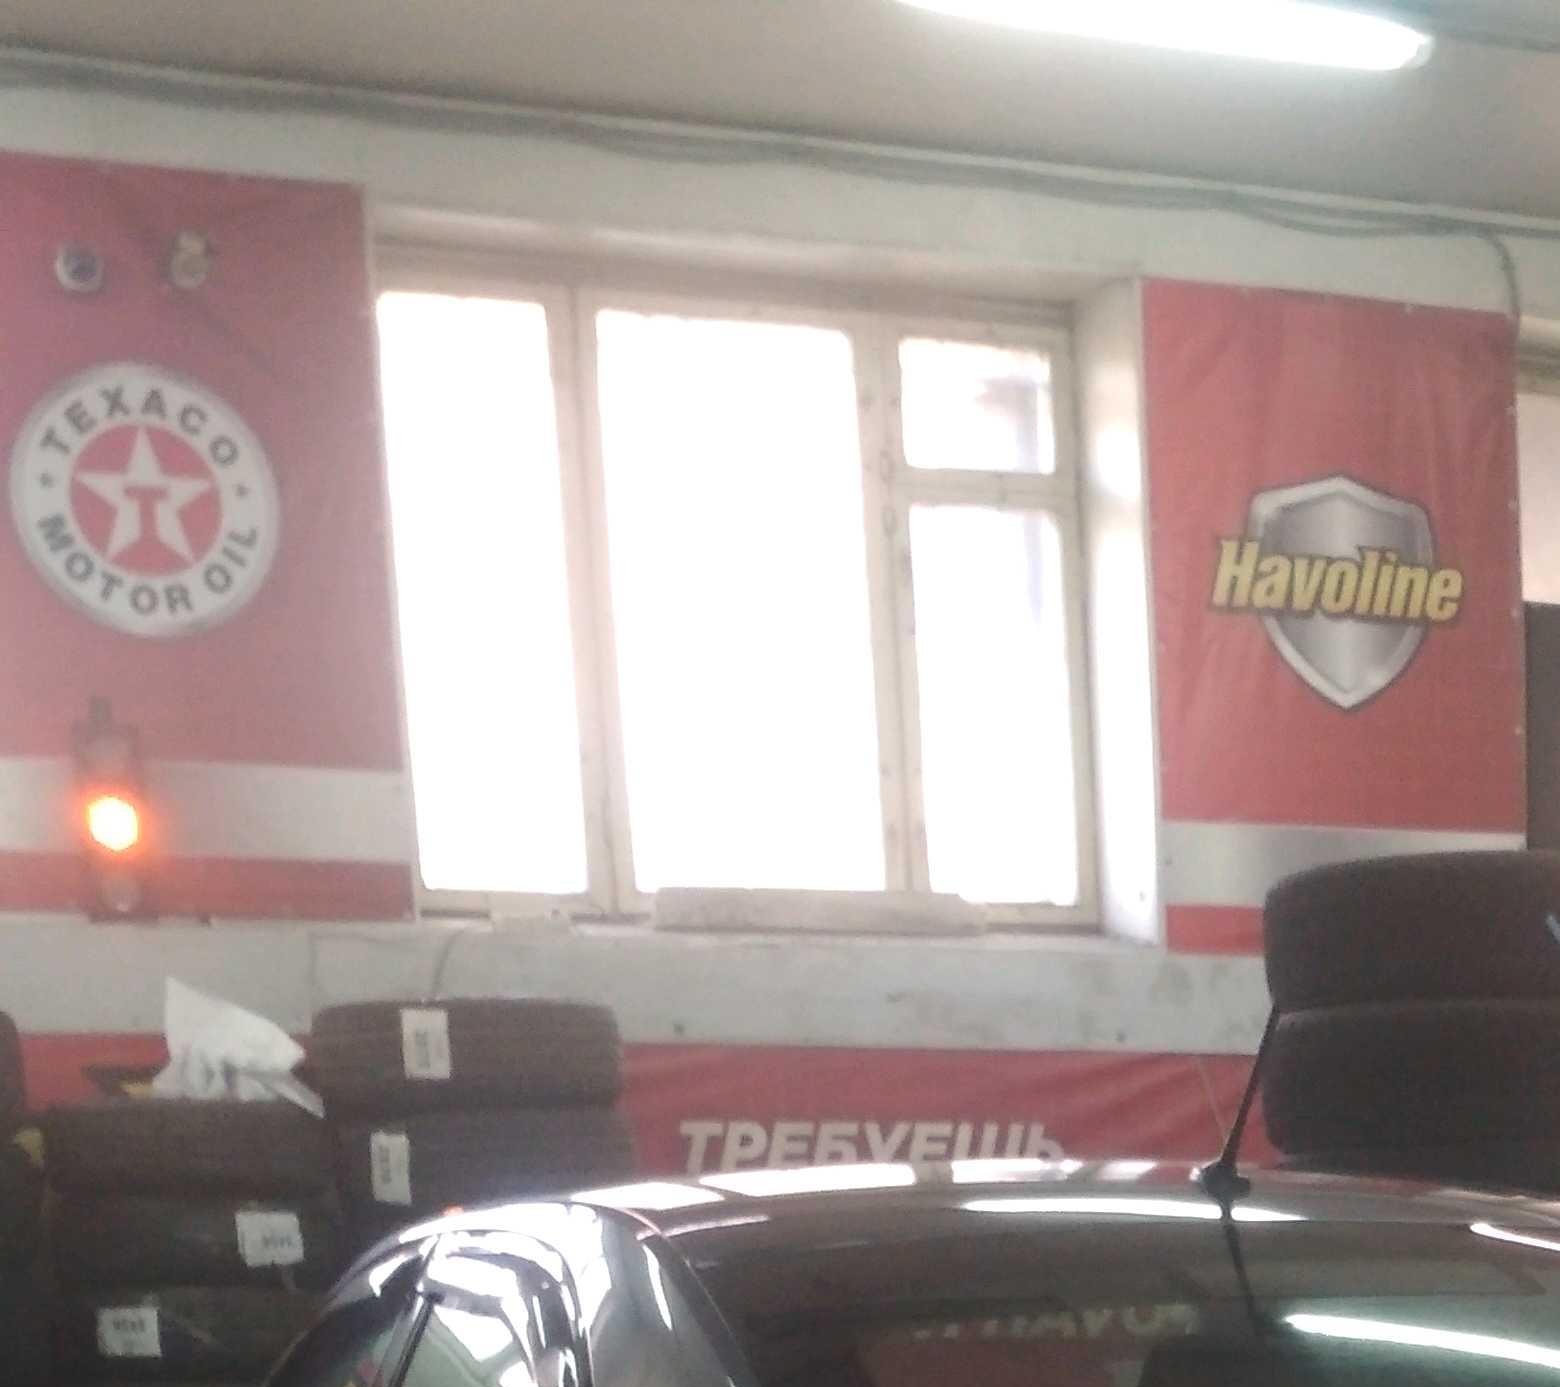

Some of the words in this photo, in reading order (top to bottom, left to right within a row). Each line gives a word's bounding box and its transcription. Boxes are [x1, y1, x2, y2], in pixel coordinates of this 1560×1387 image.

[39, 386, 241, 464] TEXACO
[38, 514, 192, 616] MOTOR
[206, 524, 258, 596] OIL
[1210, 538, 1465, 622] Havoline
